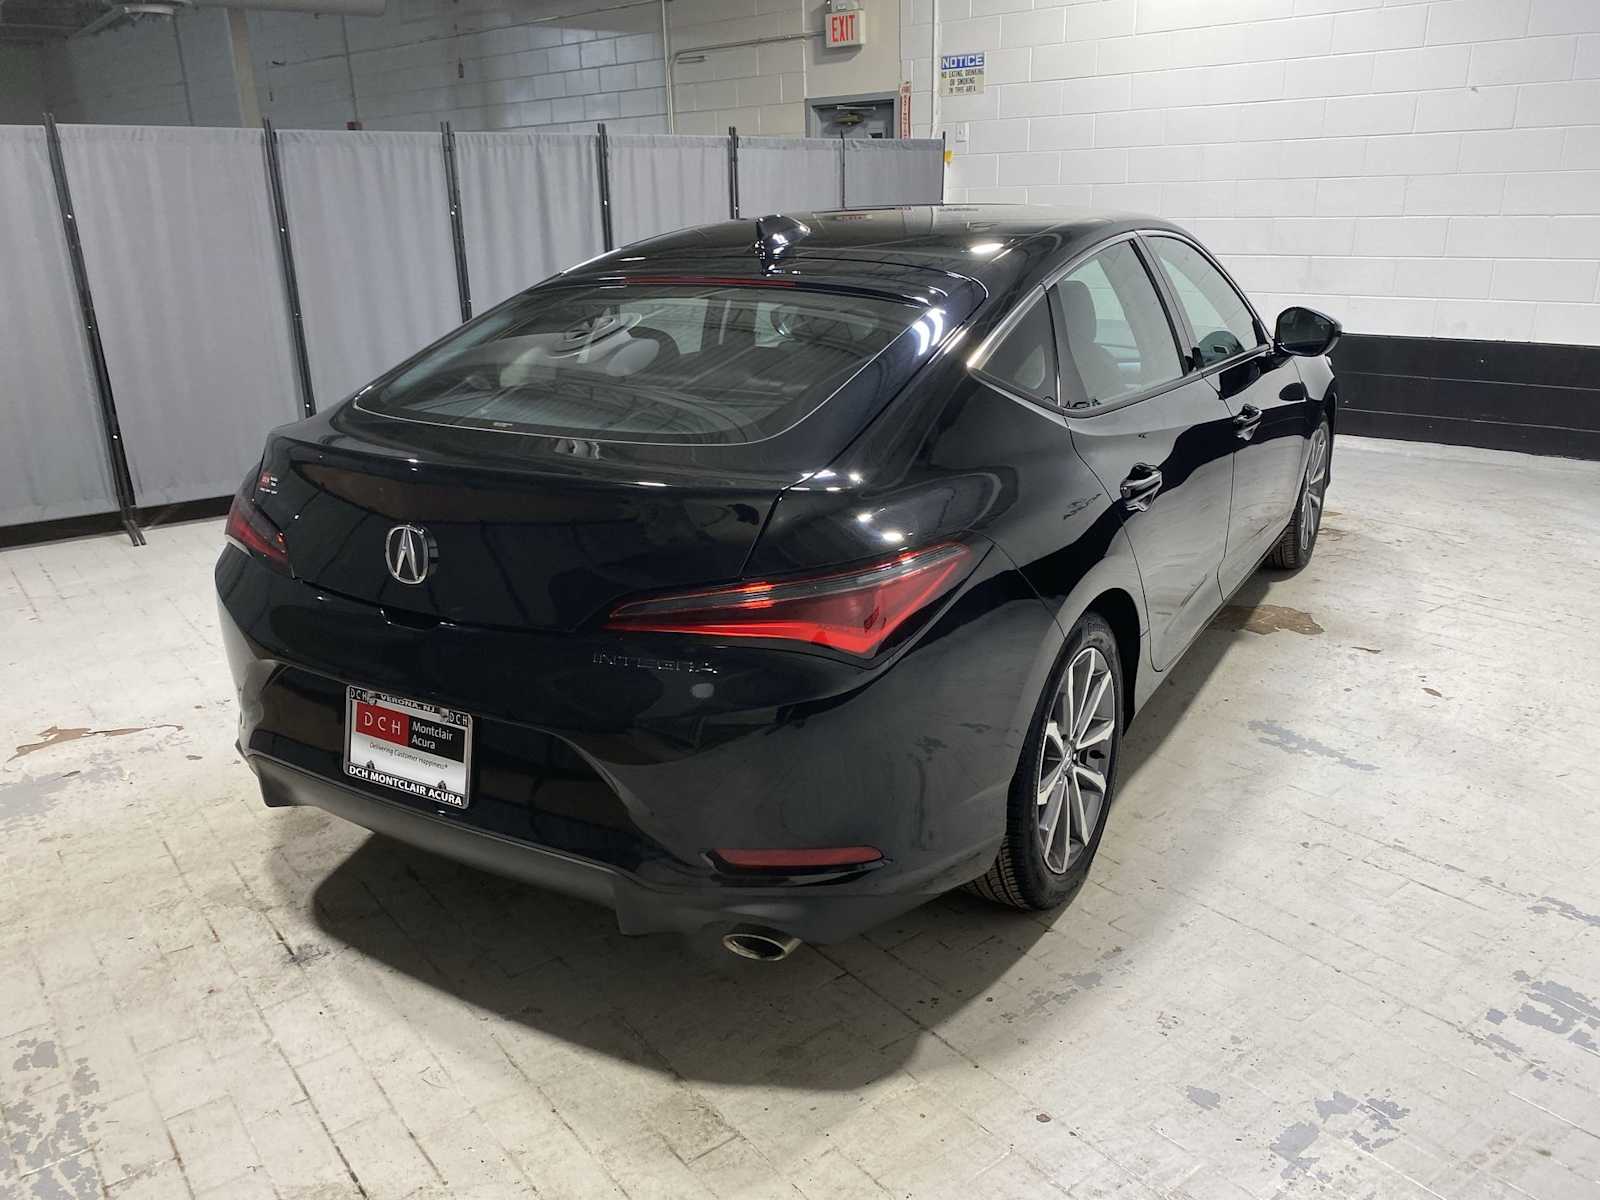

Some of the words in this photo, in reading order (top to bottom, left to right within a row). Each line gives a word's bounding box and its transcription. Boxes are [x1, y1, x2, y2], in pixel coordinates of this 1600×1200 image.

[832, 15, 855, 42] EXIT
[942, 55, 984, 69] NOTICE
[448, 711, 468, 726] DCH
[412, 720, 453, 741] Montclair
[411, 734, 436, 750] Acura
[349, 765, 371, 779] DCH
[370, 771, 426, 796] MONTCLAIR
[428, 788, 463, 806] ACURA
